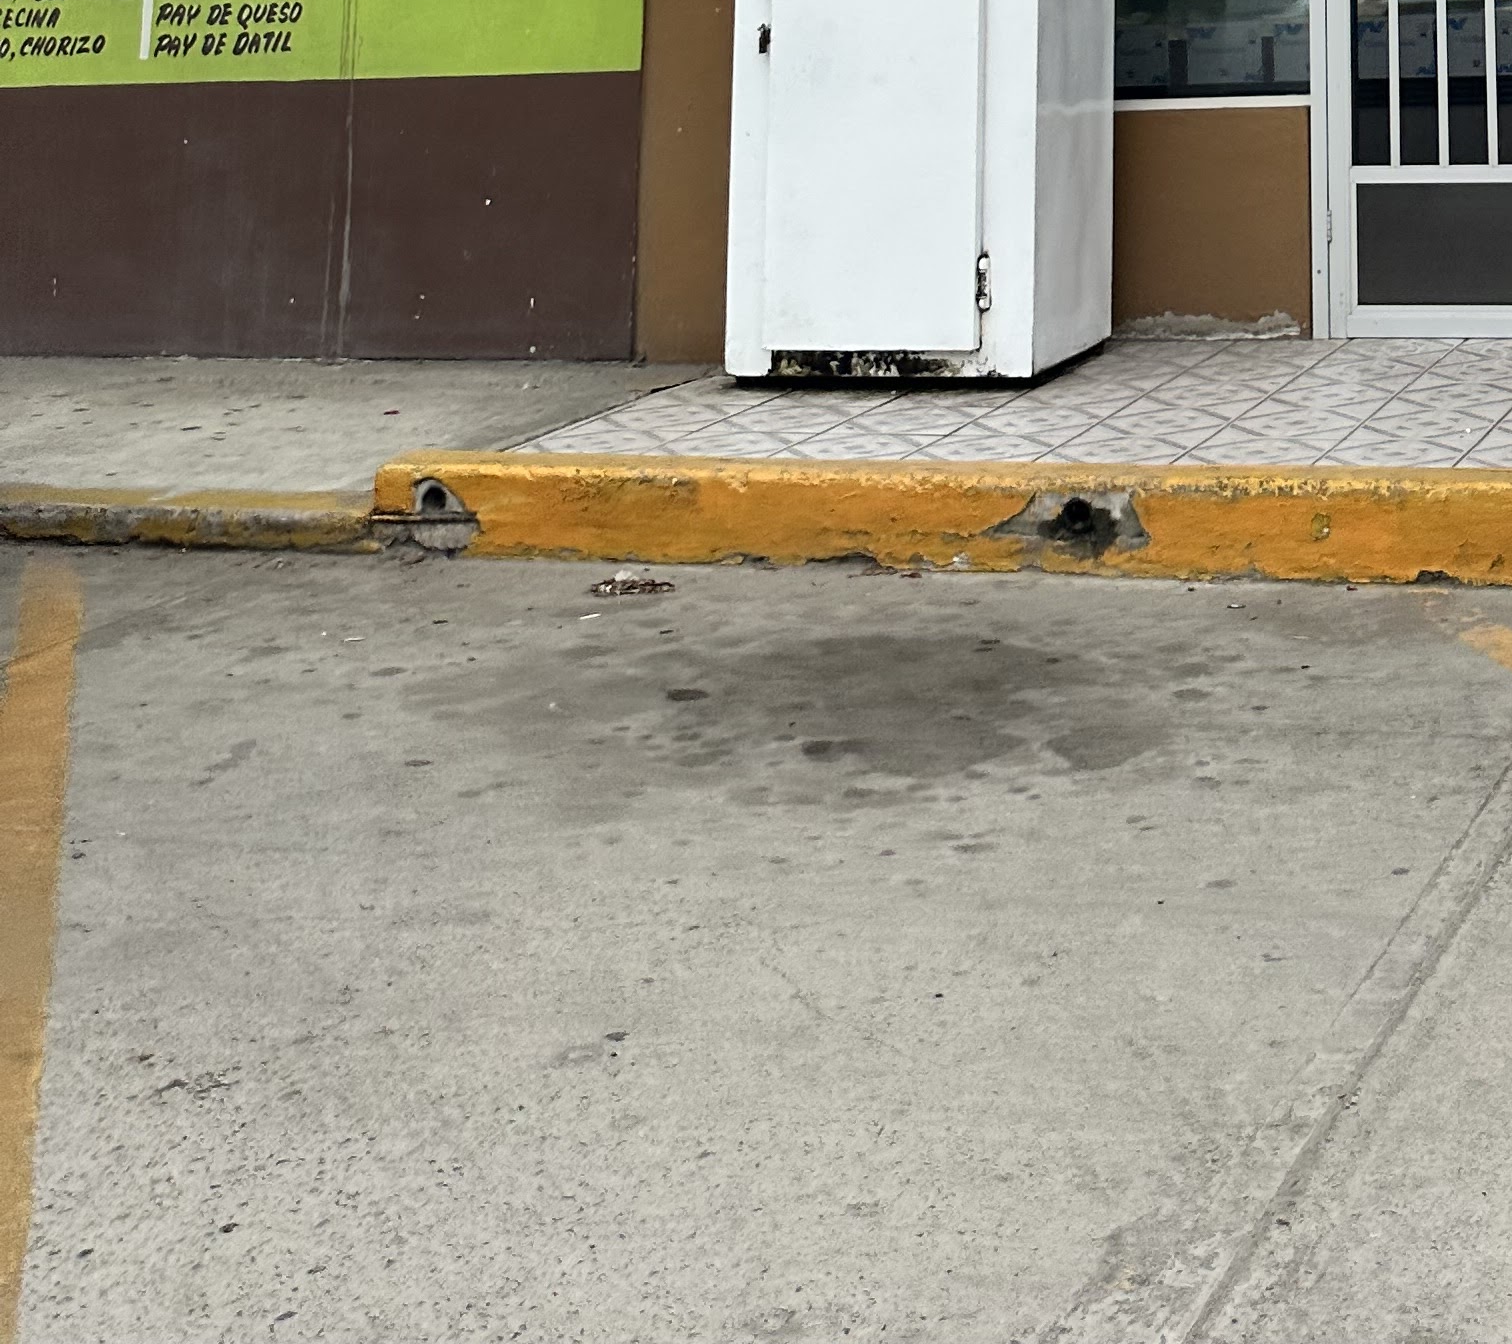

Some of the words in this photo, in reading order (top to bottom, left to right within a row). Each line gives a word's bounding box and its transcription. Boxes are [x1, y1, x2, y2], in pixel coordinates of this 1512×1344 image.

[0, 7, 61, 30] ECINA
[156, 2, 202, 27] PAY
[206, 3, 233, 26] DE
[237, 1, 303, 30] QUESO
[153, 32, 198, 58] PAY
[201, 32, 228, 56] DE
[232, 30, 292, 56] DATIL
